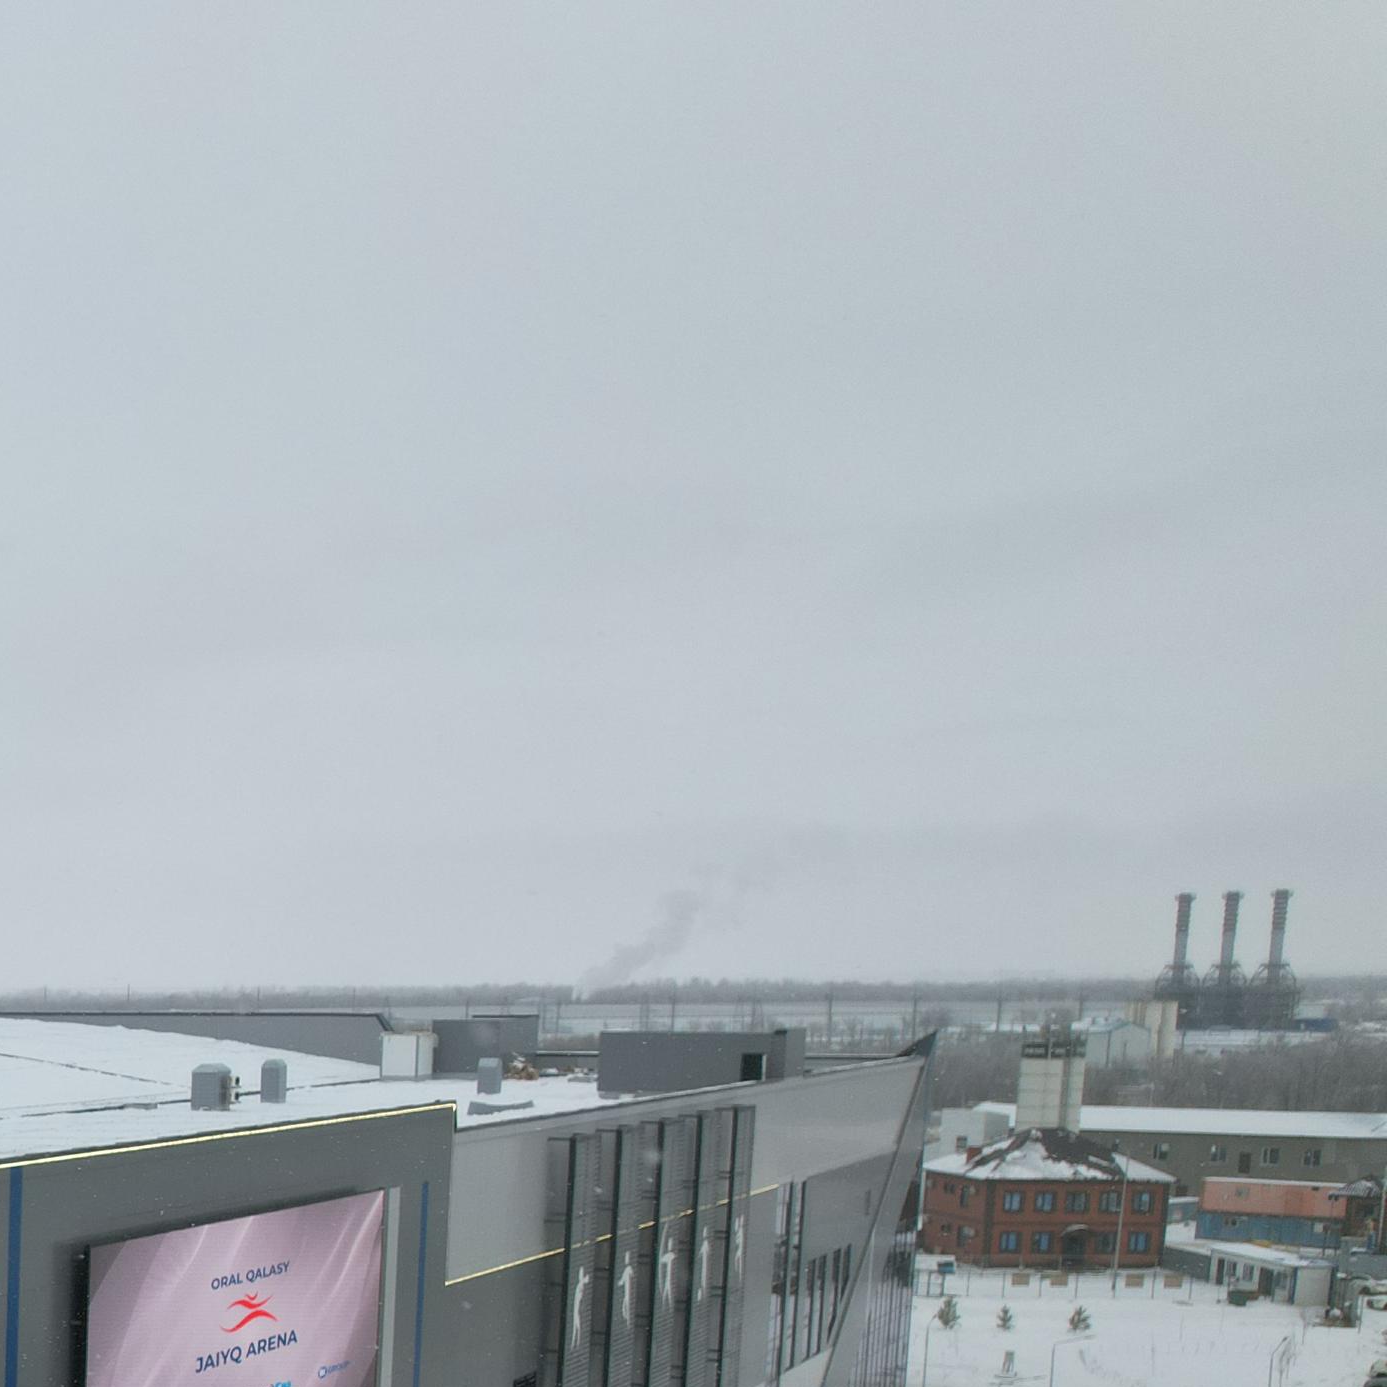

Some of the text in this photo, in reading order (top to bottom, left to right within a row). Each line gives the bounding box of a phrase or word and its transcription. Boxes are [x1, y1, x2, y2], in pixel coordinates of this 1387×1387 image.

[211, 1259, 290, 1290] ORAL QALASY
[195, 1329, 298, 1374] JAIYQ ARENA
